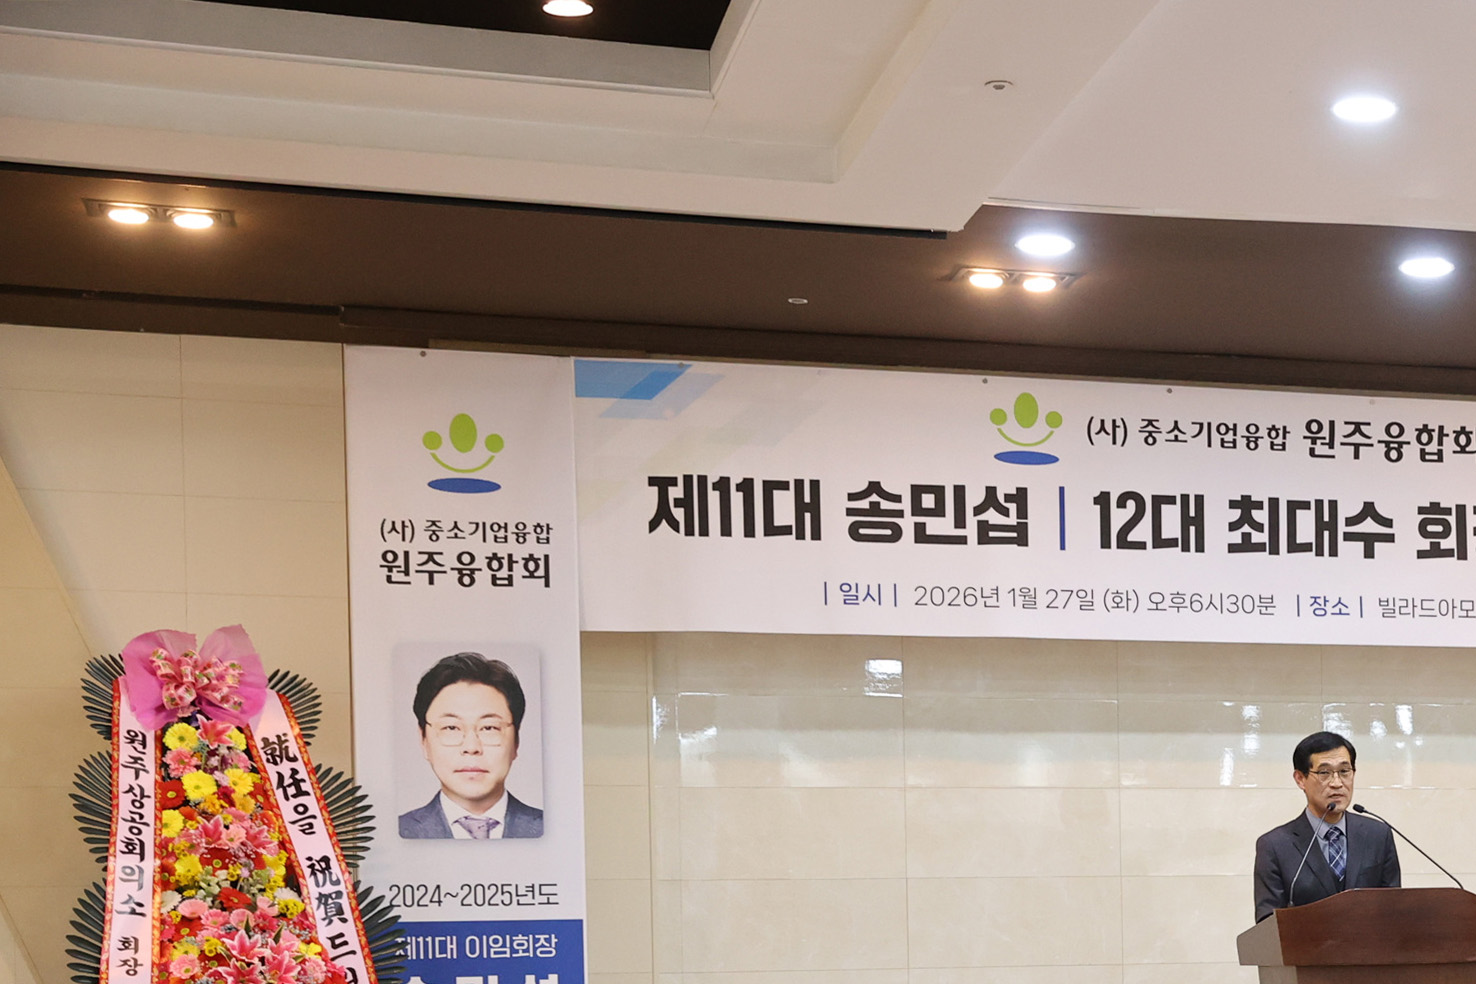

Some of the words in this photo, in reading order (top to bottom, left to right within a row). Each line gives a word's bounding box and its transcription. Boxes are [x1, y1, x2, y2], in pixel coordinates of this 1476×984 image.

[1087, 416, 1128, 448] (사)
[1138, 417, 1291, 452] 중소기업융합
[380, 518, 415, 543] (사)
[423, 519, 553, 545] 중소기업융합
[648, 474, 821, 541] 제11대
[845, 480, 1030, 548] 송민섭
[1093, 490, 1205, 553] 12대
[1227, 494, 1396, 560] 최대수
[379, 549, 551, 588] 원주융합회
[838, 582, 883, 606] 일시
[913, 584, 1001, 609] 2026년
[1007, 586, 1038, 611] 1월
[1045, 587, 1095, 612] 27일
[1103, 589, 1139, 614] (화)
[1147, 590, 1277, 617] 오후6시30분
[1309, 595, 1350, 619] 장소
[260, 733, 318, 836] 就任을
[114, 728, 151, 918] 원주상공회의소
[389, 882, 560, 908] 2024~2025년도
[116, 936, 144, 977] 회장
[466, 933, 559, 959] 이임회장
